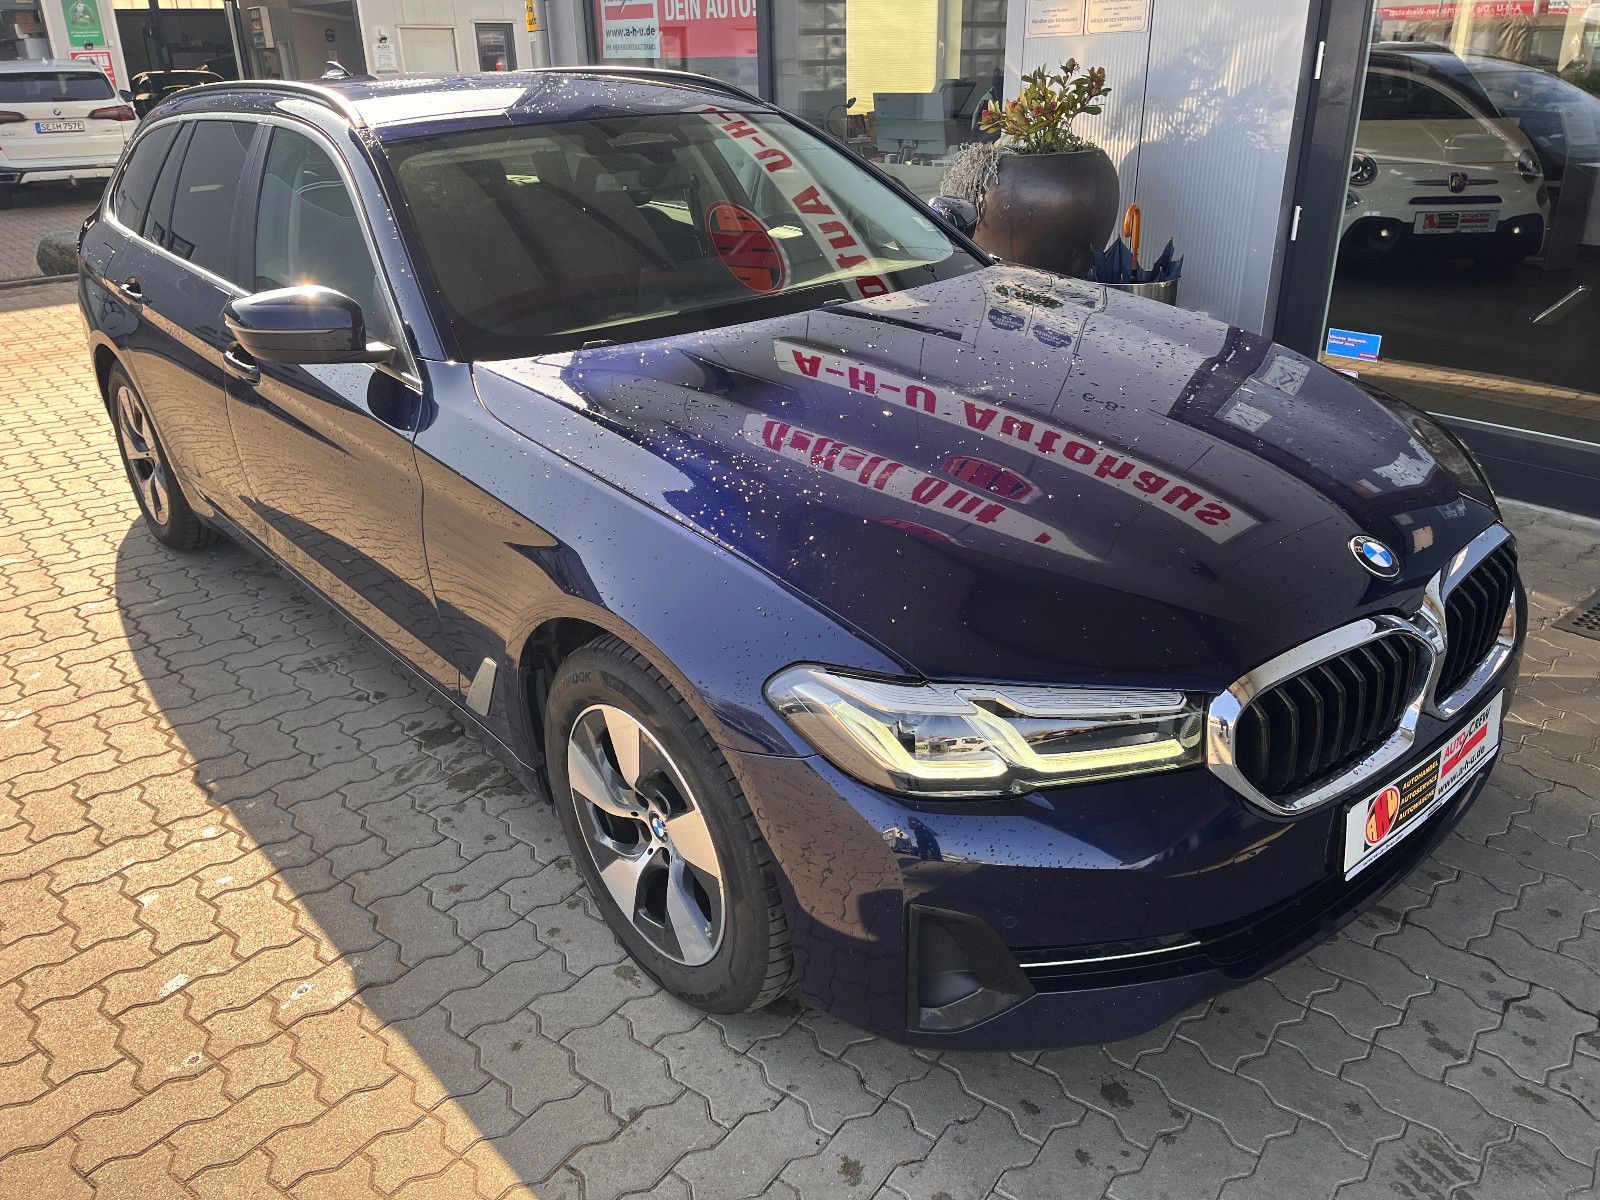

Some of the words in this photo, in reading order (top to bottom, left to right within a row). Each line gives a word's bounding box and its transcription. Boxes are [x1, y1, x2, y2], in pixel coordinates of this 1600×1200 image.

[665, 0, 700, 20] DEIN
[706, 0, 757, 19] AUTO!
[605, 25, 656, 37] www.a-h-u.de
[1438, 745, 1486, 795] www.a-h-u.de
